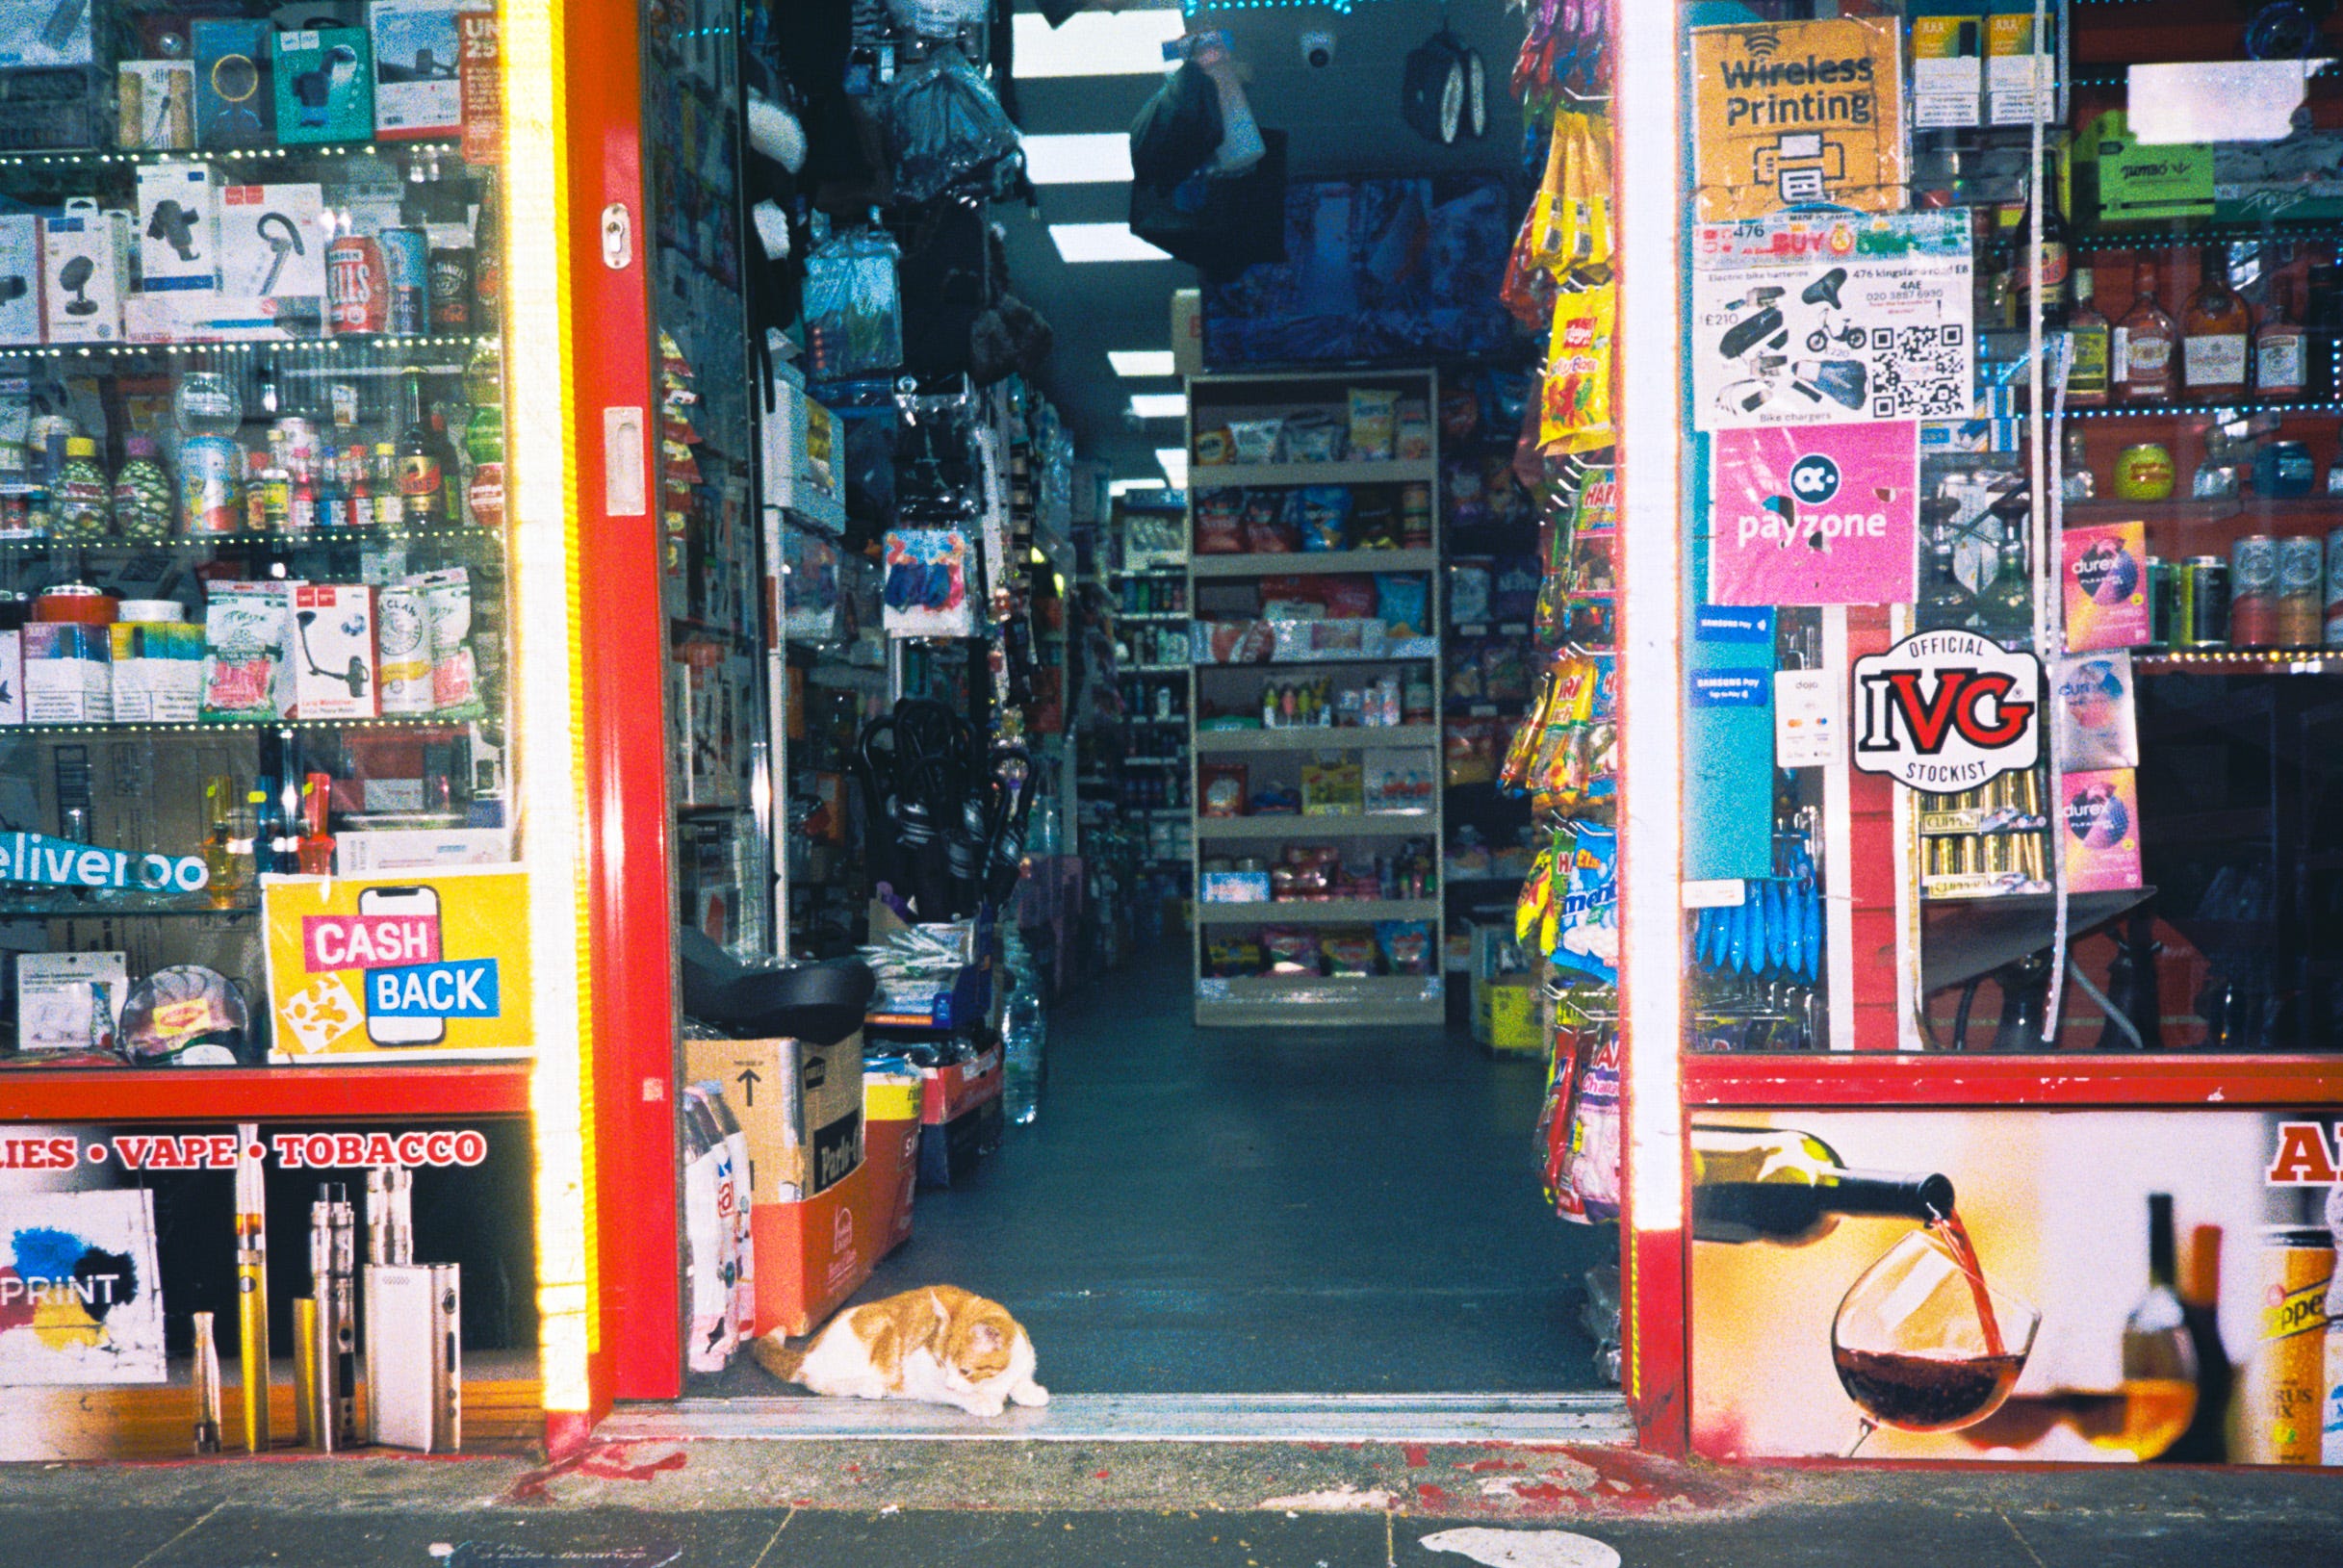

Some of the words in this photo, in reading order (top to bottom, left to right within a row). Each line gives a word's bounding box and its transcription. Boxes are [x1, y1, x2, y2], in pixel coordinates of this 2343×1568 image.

[1721, 55, 1874, 90] Wireless
[1727, 90, 1871, 126] Printing
[1733, 225, 1764, 238] 476
[1745, 271, 1765, 280] bike
[1853, 270, 1874, 279] 476
[1875, 267, 1926, 279] kingsla
[1866, 291, 1887, 301] 020
[1705, 313, 1738, 325] £210
[1760, 413, 1782, 423] Bike
[1785, 412, 1831, 424] chargers
[1738, 512, 1887, 548] payzone
[1909, 636, 1984, 658] OFFICIAL
[1697, 678, 1741, 687] SAMSUNG
[1742, 679, 1759, 688] Pay
[1859, 668, 2035, 755] IVG
[1906, 760, 1986, 783] STOCKIST
[315, 922, 427, 964] CASH
[377, 968, 487, 1010] BACK
[0, 1138, 77, 1170] IES
[114, 1137, 237, 1170] VAPE
[276, 1130, 486, 1167] TOBACCO
[2269, 1124, 2343, 1184] A
[2, 1274, 119, 1305] PRINT
